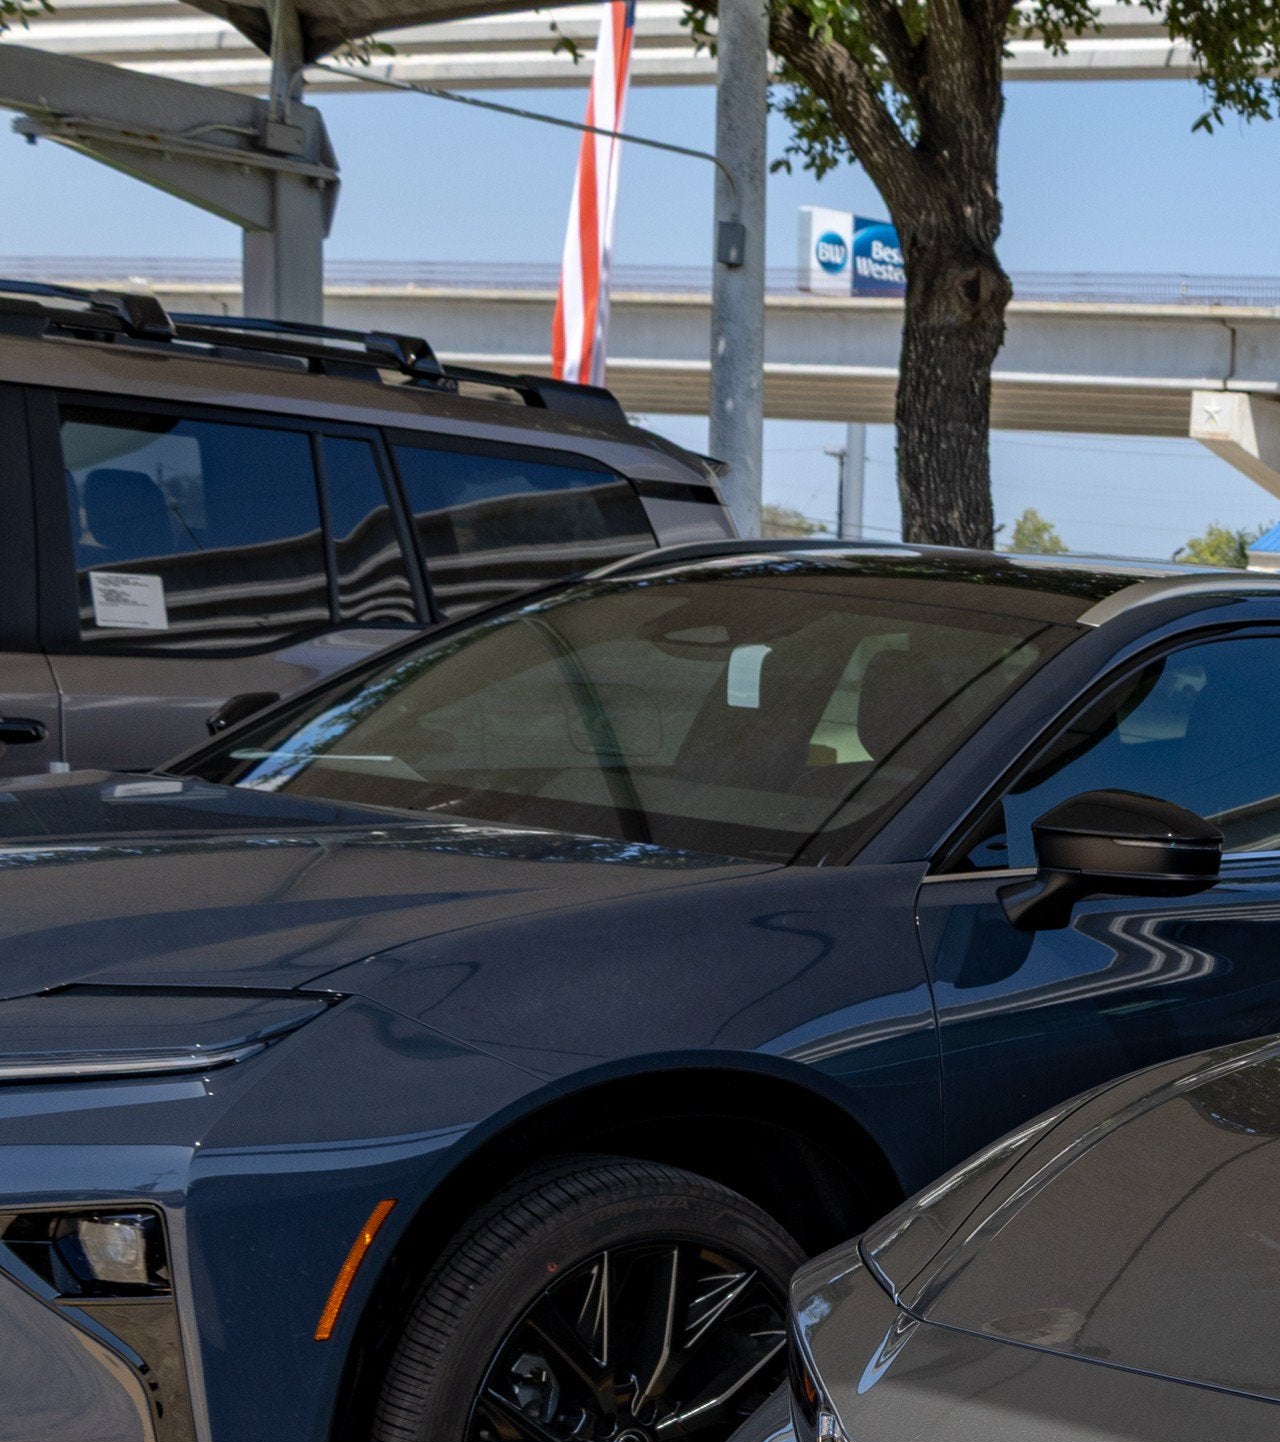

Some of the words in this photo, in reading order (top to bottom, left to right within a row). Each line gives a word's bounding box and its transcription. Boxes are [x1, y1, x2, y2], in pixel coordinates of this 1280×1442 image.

[818, 242, 847, 265] BW
[871, 240, 905, 264] Bes
[856, 255, 908, 284] Weste
